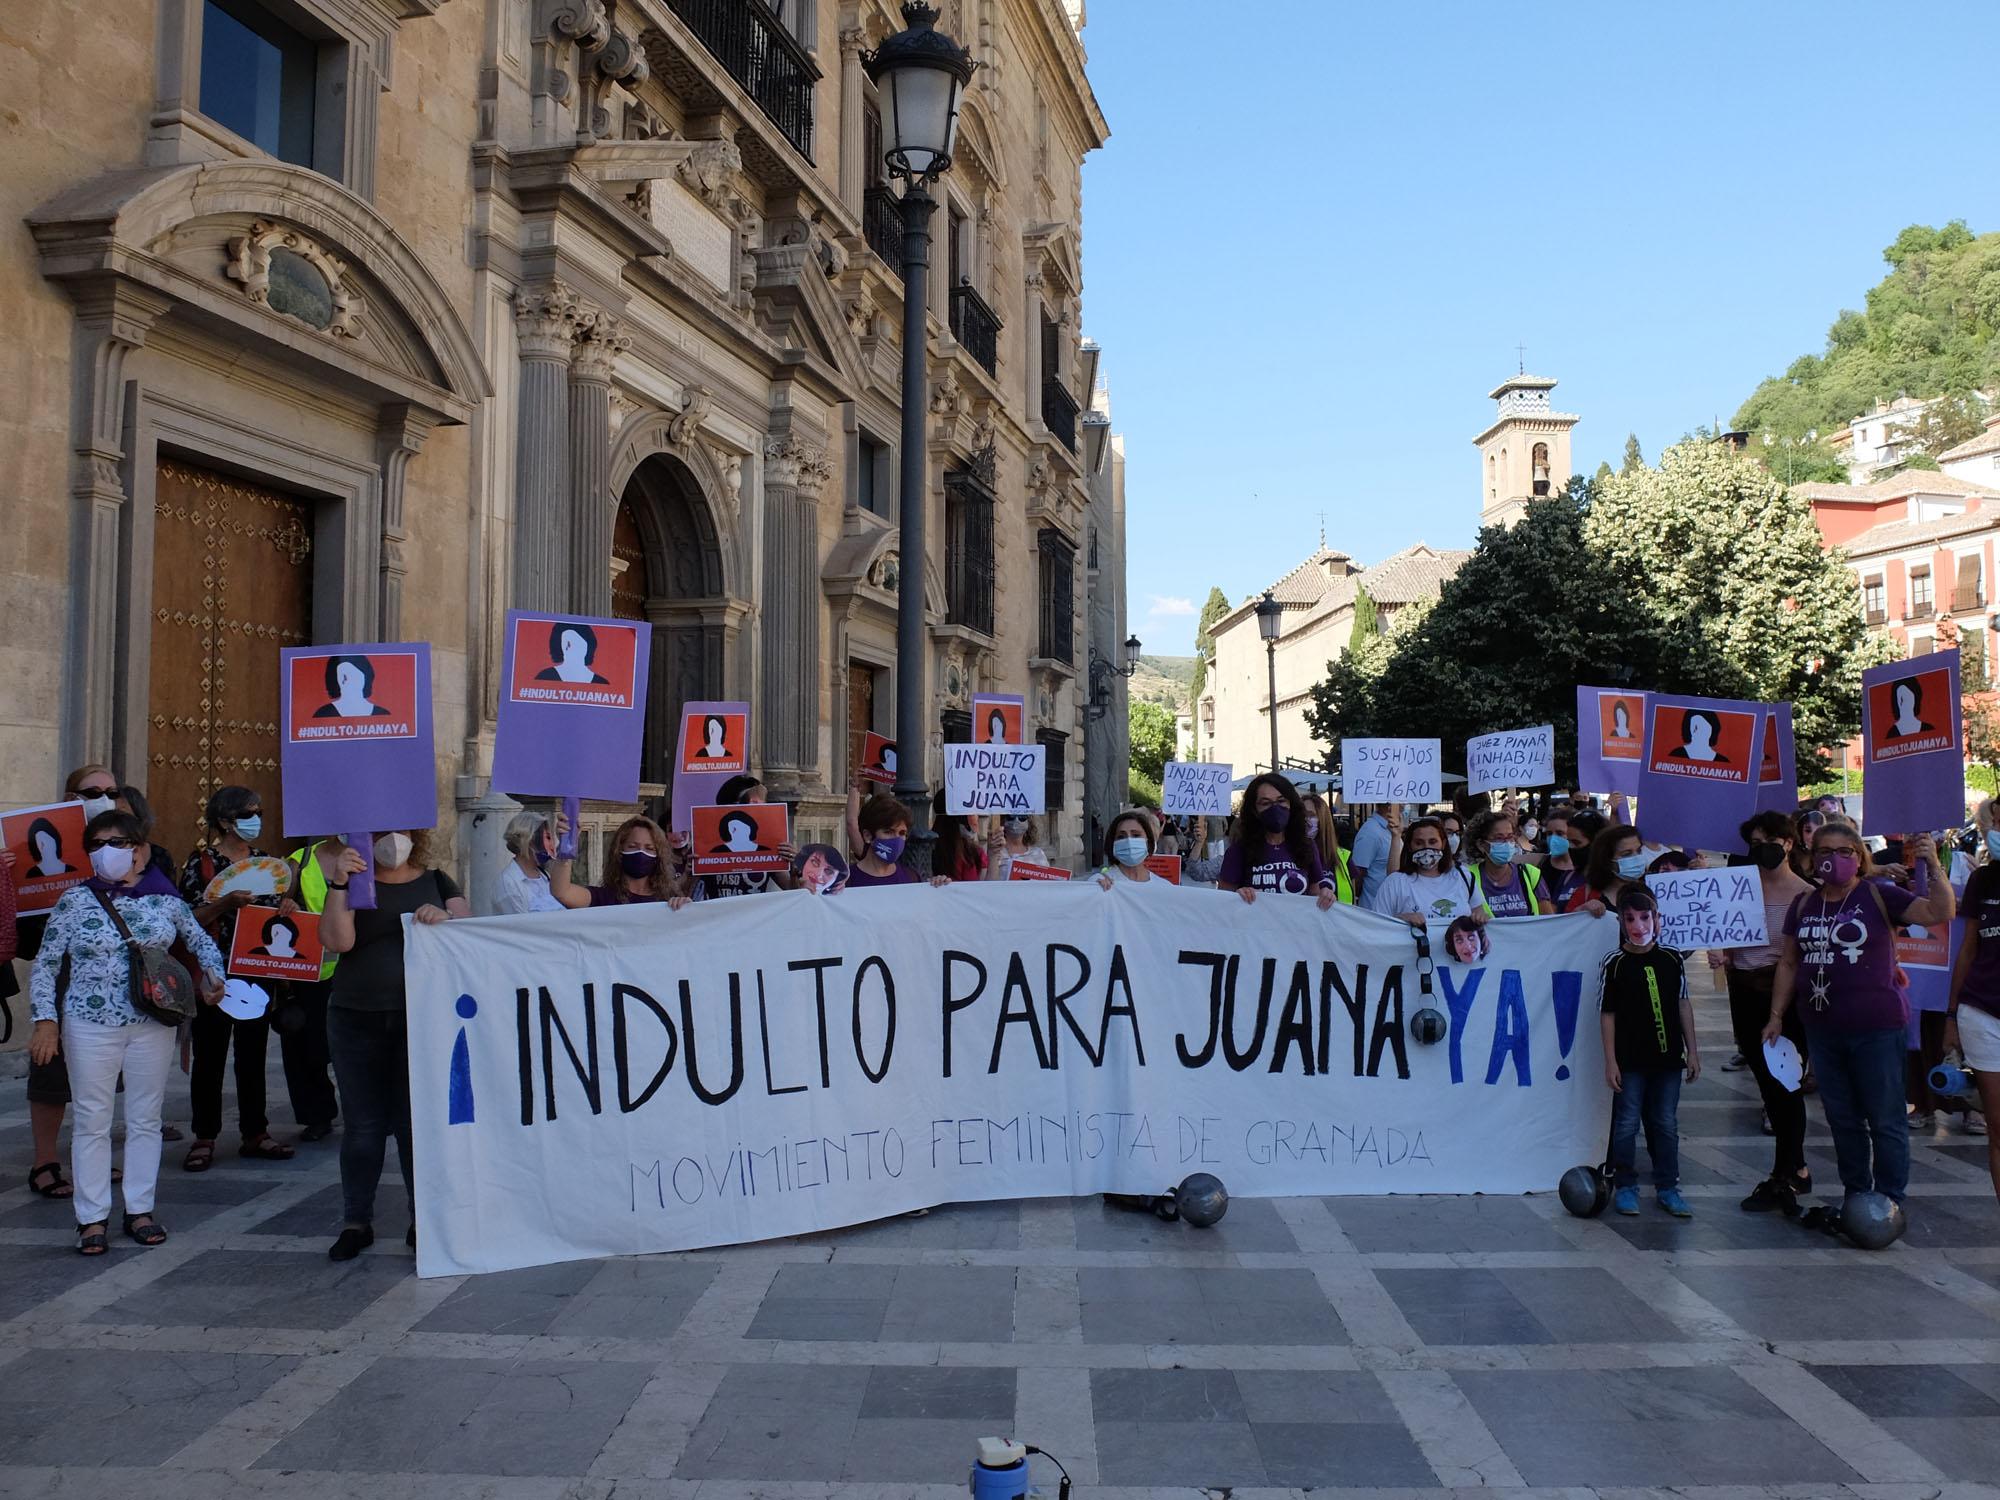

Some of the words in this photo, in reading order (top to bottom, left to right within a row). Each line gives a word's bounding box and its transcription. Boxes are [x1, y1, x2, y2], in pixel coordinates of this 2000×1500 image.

[519, 687, 626, 704] #INDULTOJUANAYA
[298, 723, 408, 738] #INDULTOJUANAYA
[1476, 738, 1501, 750] JUEZ
[1876, 736, 1948, 759] #INDULTOJUANAYA
[687, 762, 740, 771] #INDULTOJUANAYA
[955, 749, 1035, 771] INDULTO
[1167, 765, 1229, 784] INDULTO
[1375, 764, 1400, 779] EN
[1655, 761, 1742, 780] #INDULTOJUANAYA
[977, 771, 1020, 791] PARA
[1177, 780, 1217, 796] PARA
[1354, 779, 1431, 798] PELIGRO
[962, 790, 1031, 809] JUANA
[1167, 793, 1220, 812] JUANA
[698, 855, 782, 865] #INDULTOJUANAY
[716, 874, 740, 886] PASO
[1252, 874, 1261, 885] NI
[1262, 873, 1277, 885] UN
[1654, 878, 1722, 900] BASTA
[1730, 875, 1754, 902] YA
[1688, 901, 1712, 912] DE
[1661, 911, 1746, 927] JUSTICIA
[1660, 926, 1763, 944] PATRIARCAL
[1798, 926, 1810, 938] NI
[1812, 926, 1829, 938] UN
[235, 957, 318, 972] #INDULTOJUANAYA
[942, 943, 1146, 1078] PARA
[1175, 950, 1411, 1080] JUANA
[1436, 965, 1584, 1087] YA!
[1179, 1116, 1223, 1164] DE
[1245, 1120, 1434, 1168] GRANADA
